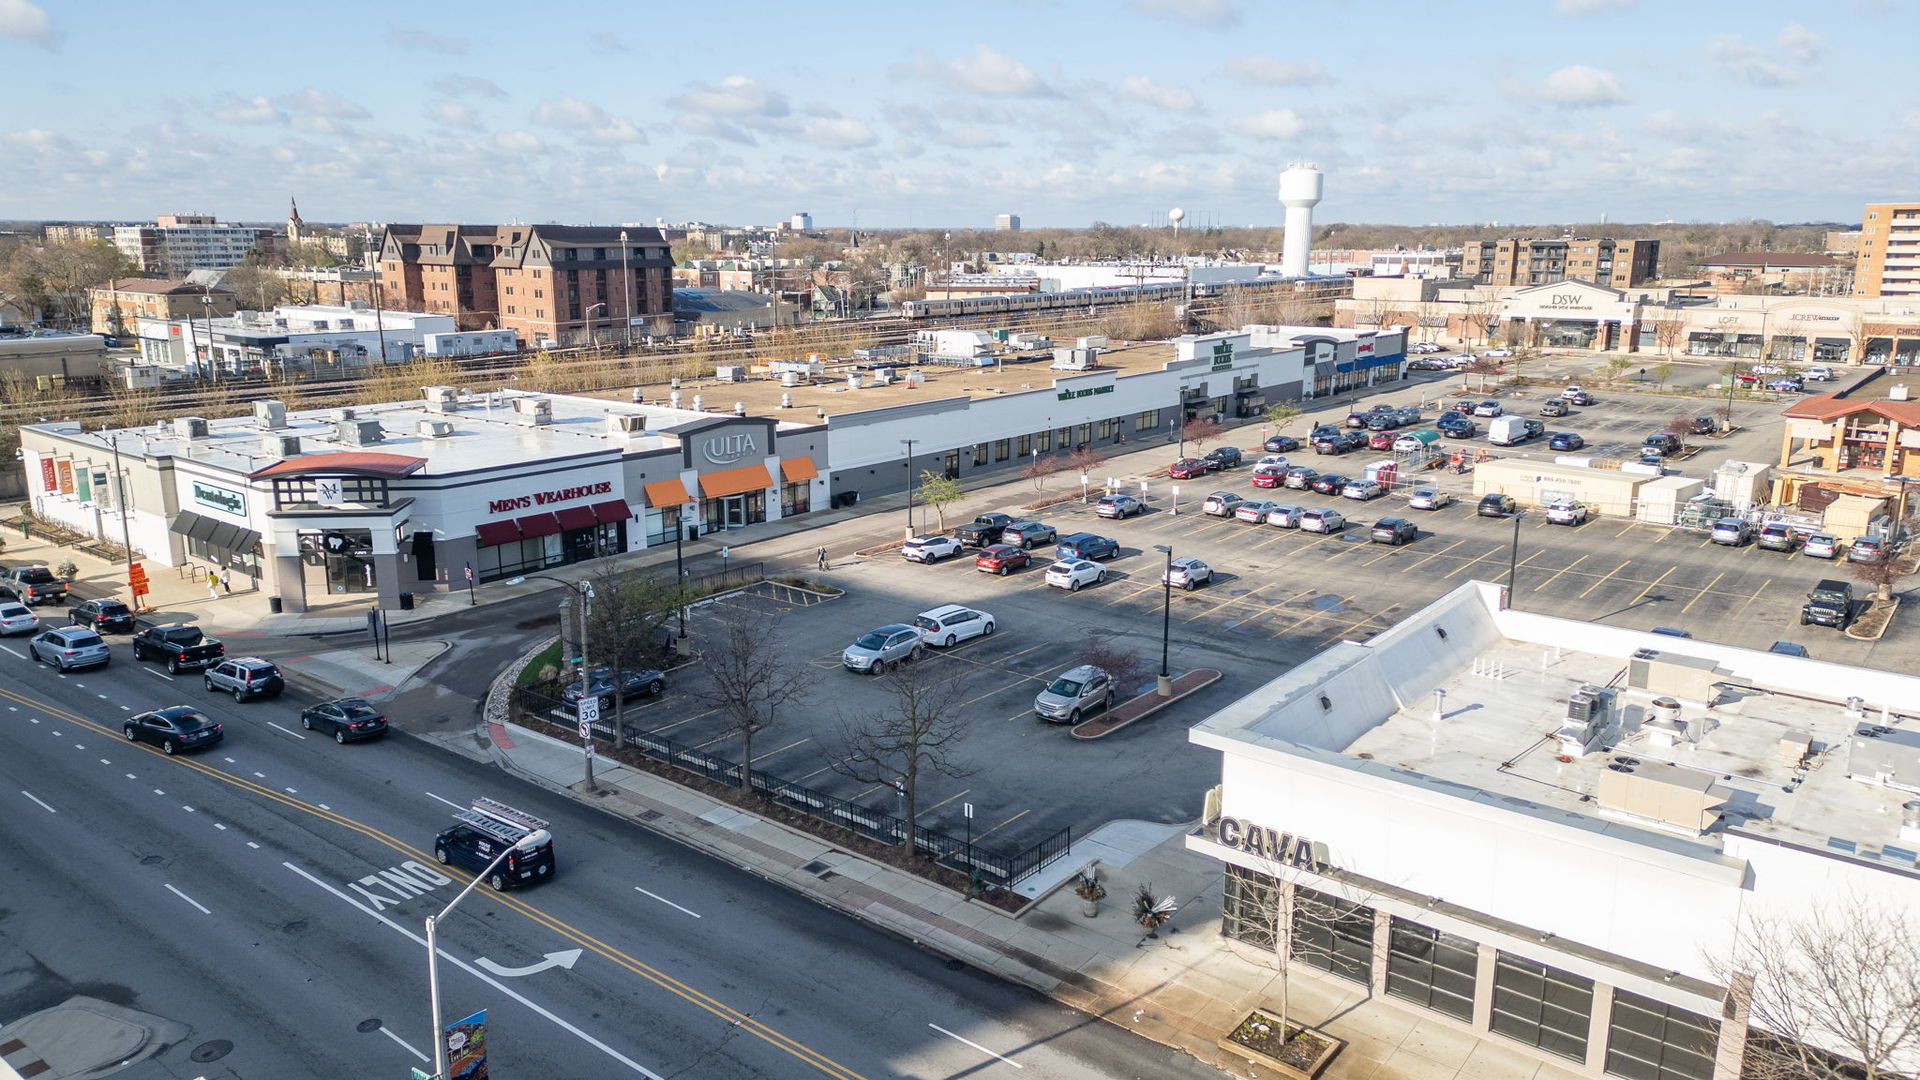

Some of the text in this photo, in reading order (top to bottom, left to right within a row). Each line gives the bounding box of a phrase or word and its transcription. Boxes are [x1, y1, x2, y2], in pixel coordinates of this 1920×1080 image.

[1552, 294, 1582, 305] DSW
[1718, 316, 1739, 324] LOFT
[711, 433, 756, 456] ULTA
[488, 481, 612, 514] MEN'S WEARHOUSE
[582, 709, 597, 721] 30
[1218, 816, 1318, 874] CAVA
[347, 861, 453, 911] ONLY
